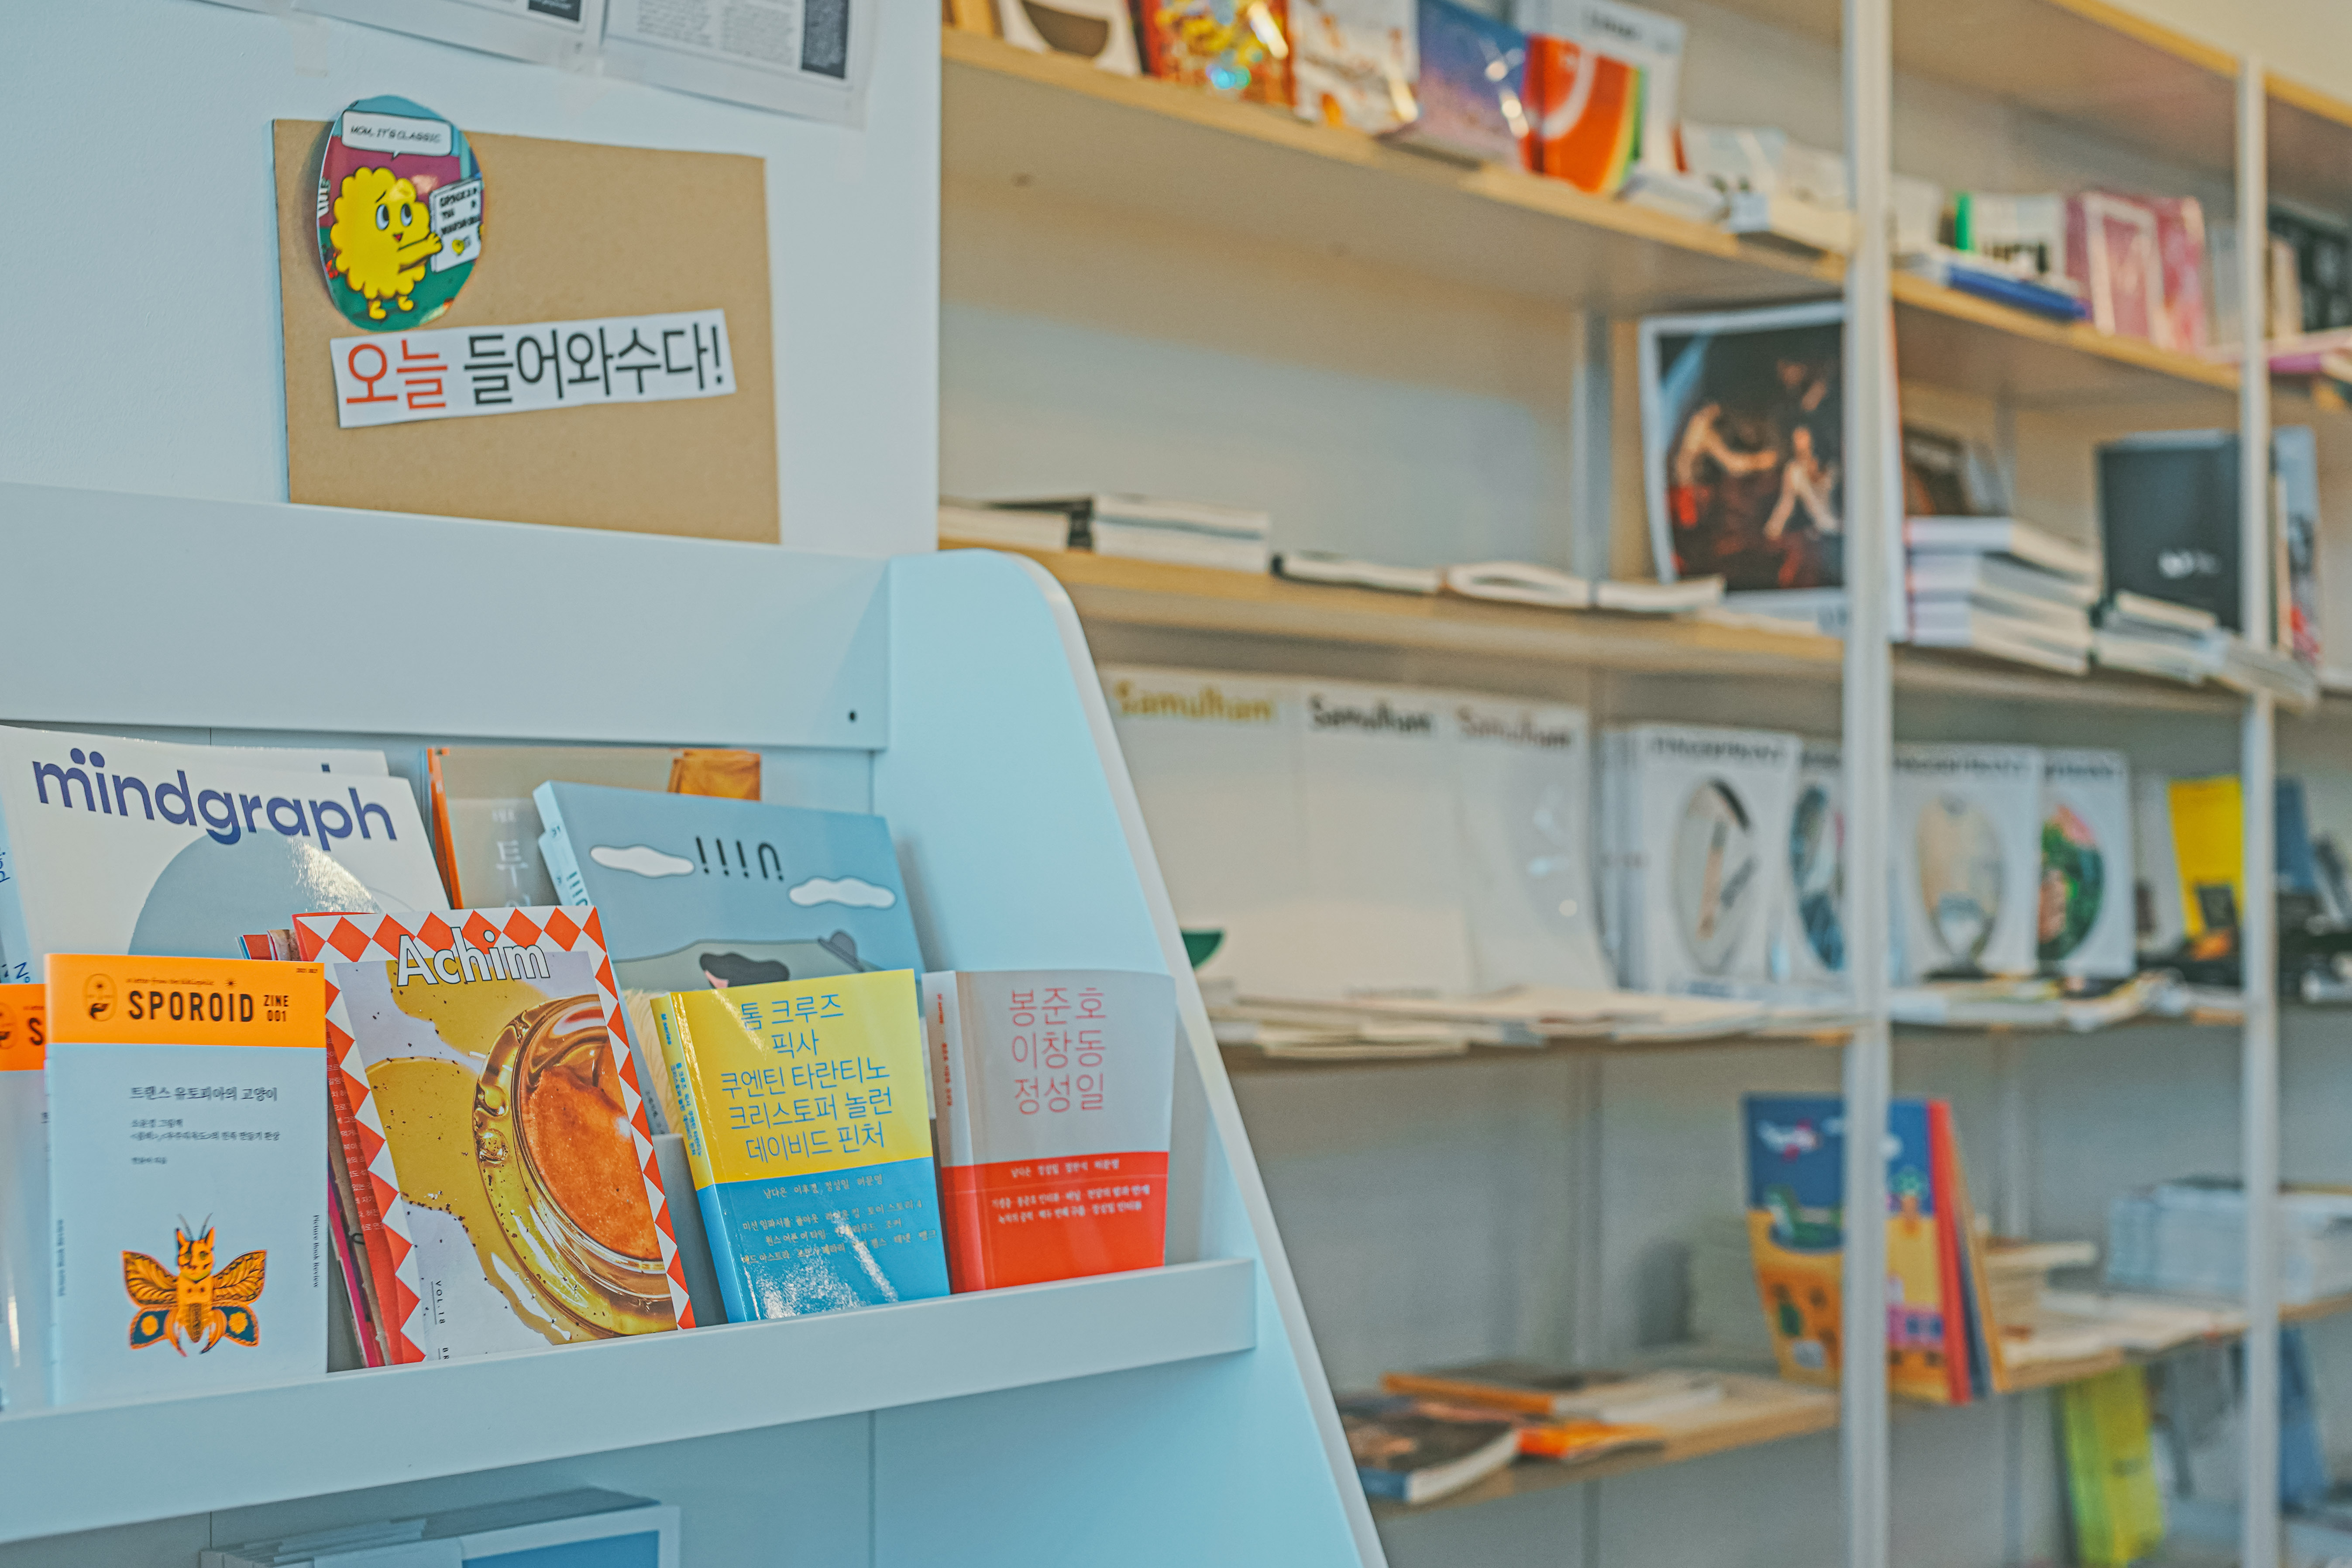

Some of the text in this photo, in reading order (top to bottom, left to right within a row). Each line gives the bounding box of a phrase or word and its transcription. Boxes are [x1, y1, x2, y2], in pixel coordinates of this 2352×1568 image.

[346, 322, 723, 410] 오늘 들어와수다!
[397, 926, 550, 987] Achim
[129, 990, 254, 1022] SPOROID
[263, 994, 289, 1007] ZINE
[267, 1010, 287, 1022] 001
[741, 994, 844, 1031] 톰 크루즈
[1009, 987, 1106, 1027] 봉준호
[772, 1028, 820, 1059] 픽사
[1011, 1029, 1106, 1069] 이창동
[129, 1086, 278, 1102] 트랜스 유토피아의 고양이
[721, 1056, 891, 1100] 쿠엔틴 타란티노
[1014, 1072, 1104, 1115] 정성일
[730, 1086, 893, 1131] 크리스토퍼 놀런
[746, 1121, 885, 1164] 데이비드 핀처
